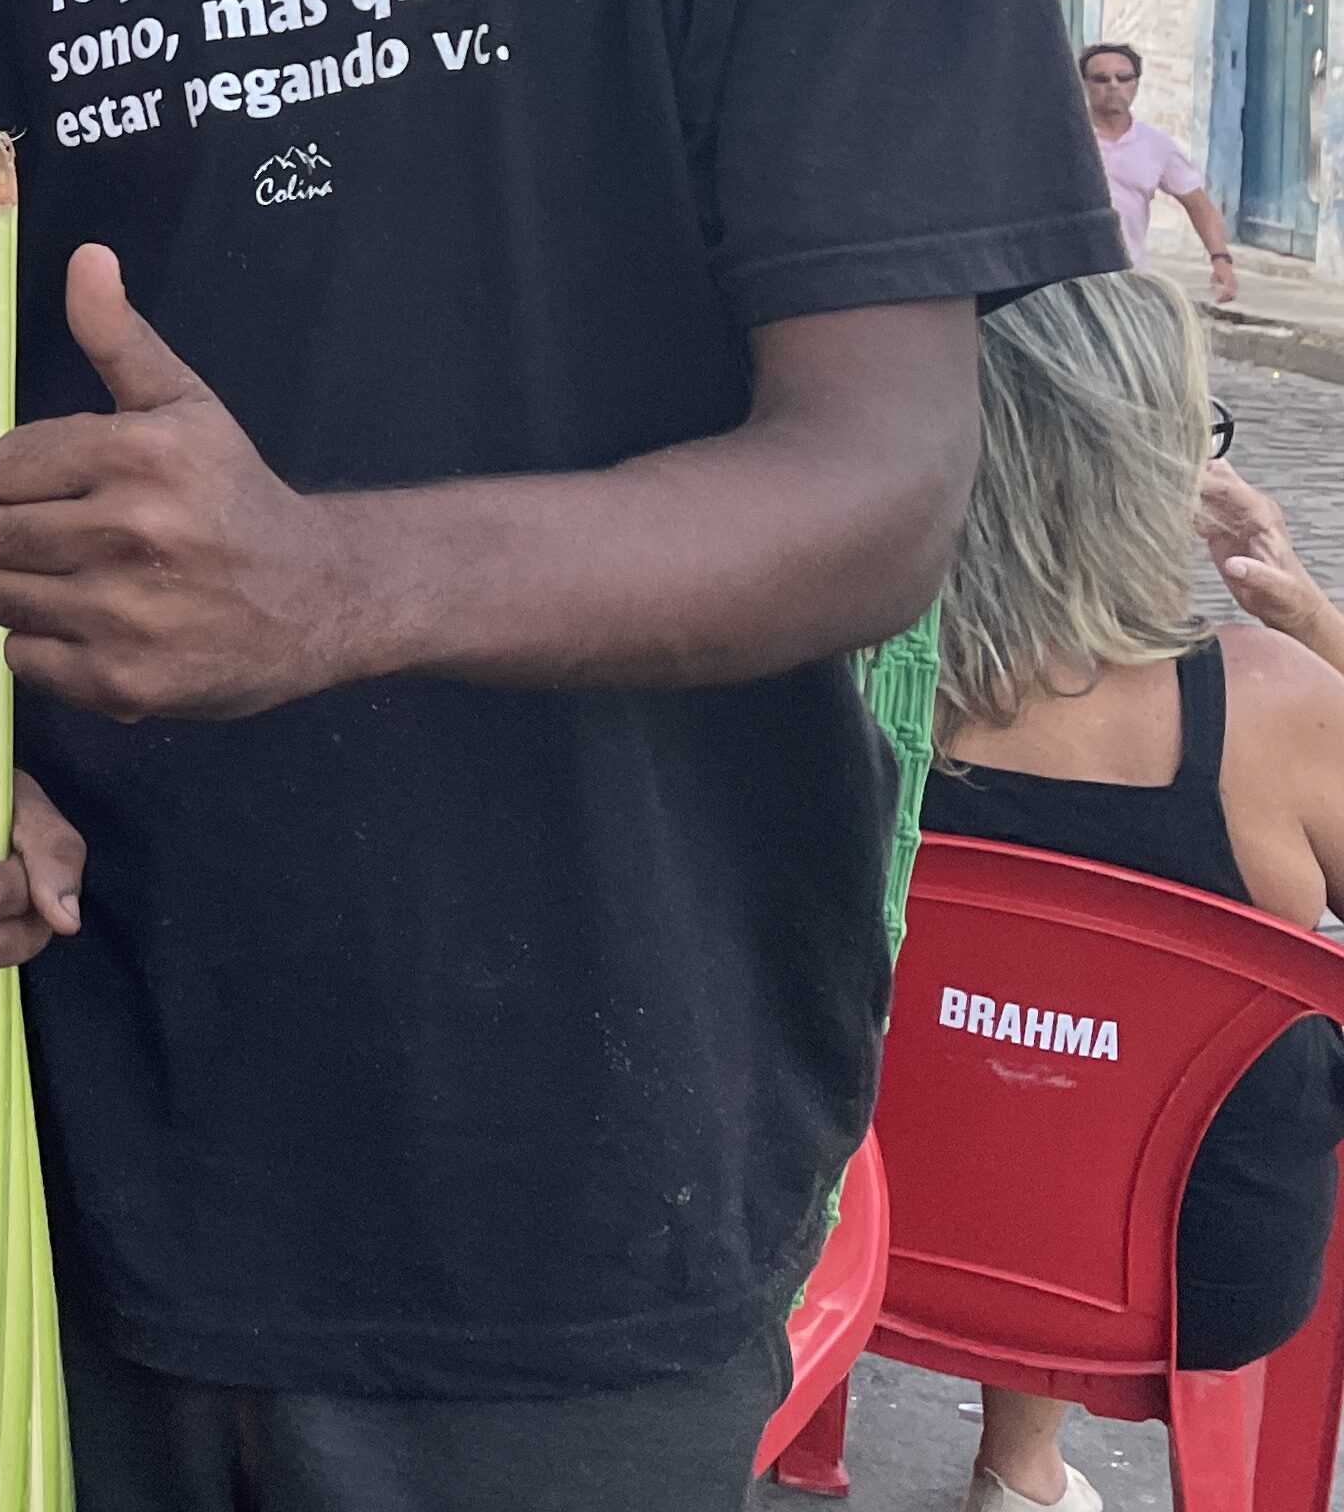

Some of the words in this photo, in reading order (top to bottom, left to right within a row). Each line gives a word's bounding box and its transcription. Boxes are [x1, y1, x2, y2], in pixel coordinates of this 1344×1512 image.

[48, 17, 179, 82] sono,
[56, 88, 162, 147] estar
[184, 31, 409, 128] pegando
[432, 24, 510, 71] vc.
[255, 174, 333, 206] Colina
[938, 986, 1119, 1061] BRAHMA
